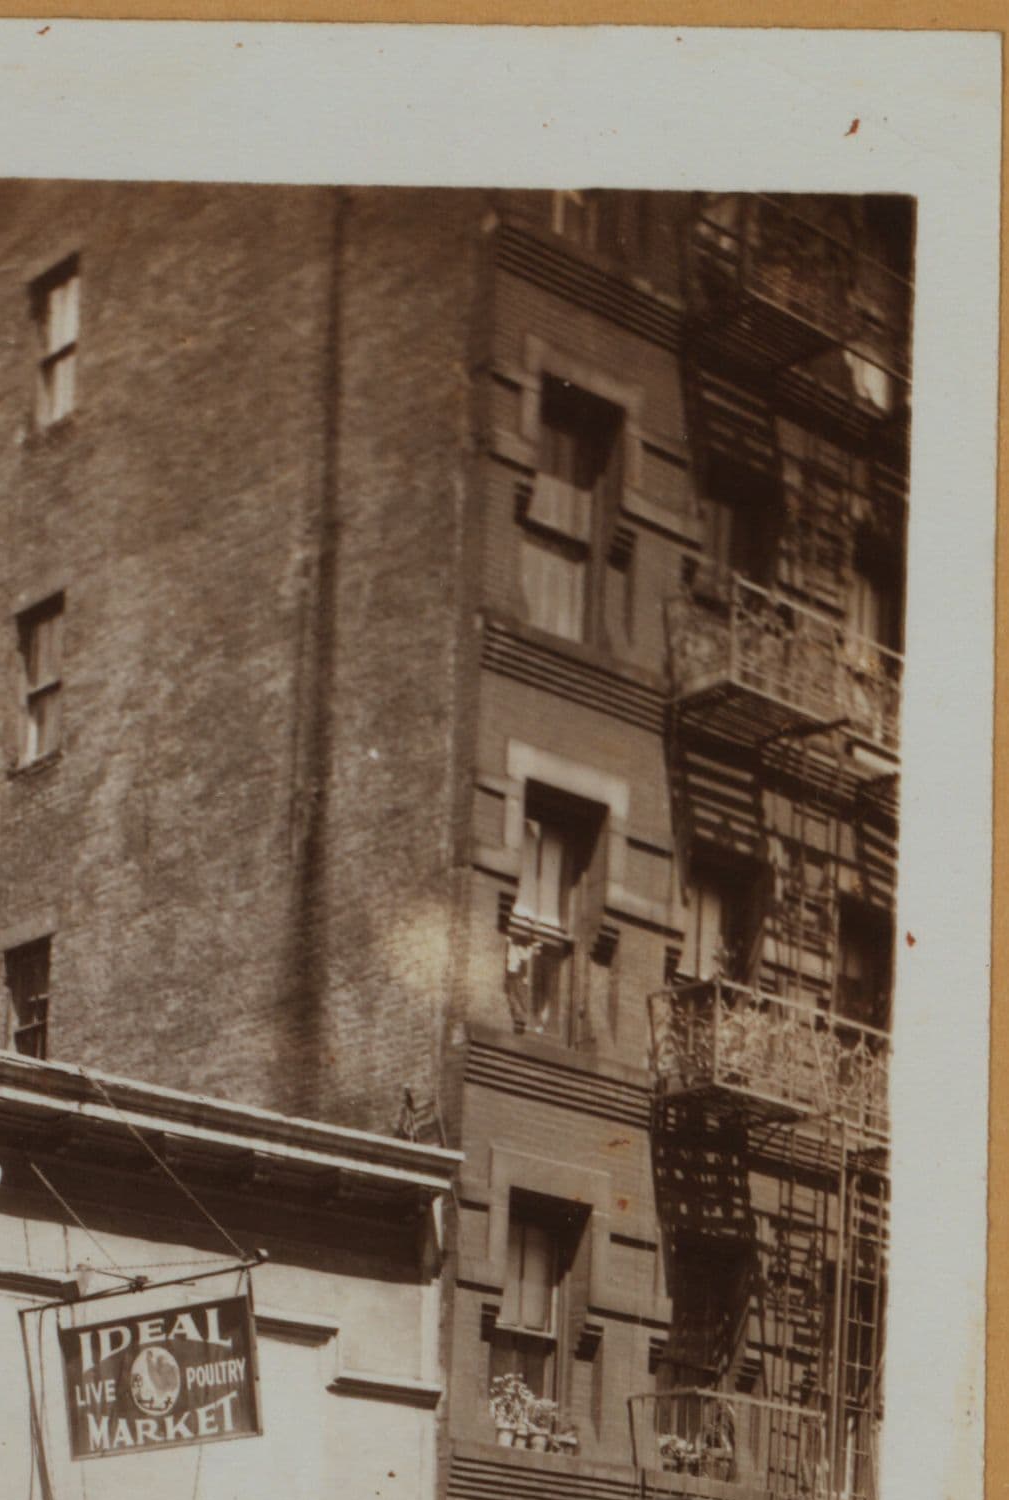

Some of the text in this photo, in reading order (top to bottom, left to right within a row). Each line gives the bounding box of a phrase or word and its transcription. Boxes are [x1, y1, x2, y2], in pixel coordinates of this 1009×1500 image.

[78, 1307, 233, 1373] IDEAL
[75, 1357, 247, 1407] LIVE POULTRY
[87, 1390, 239, 1451] MARKET
